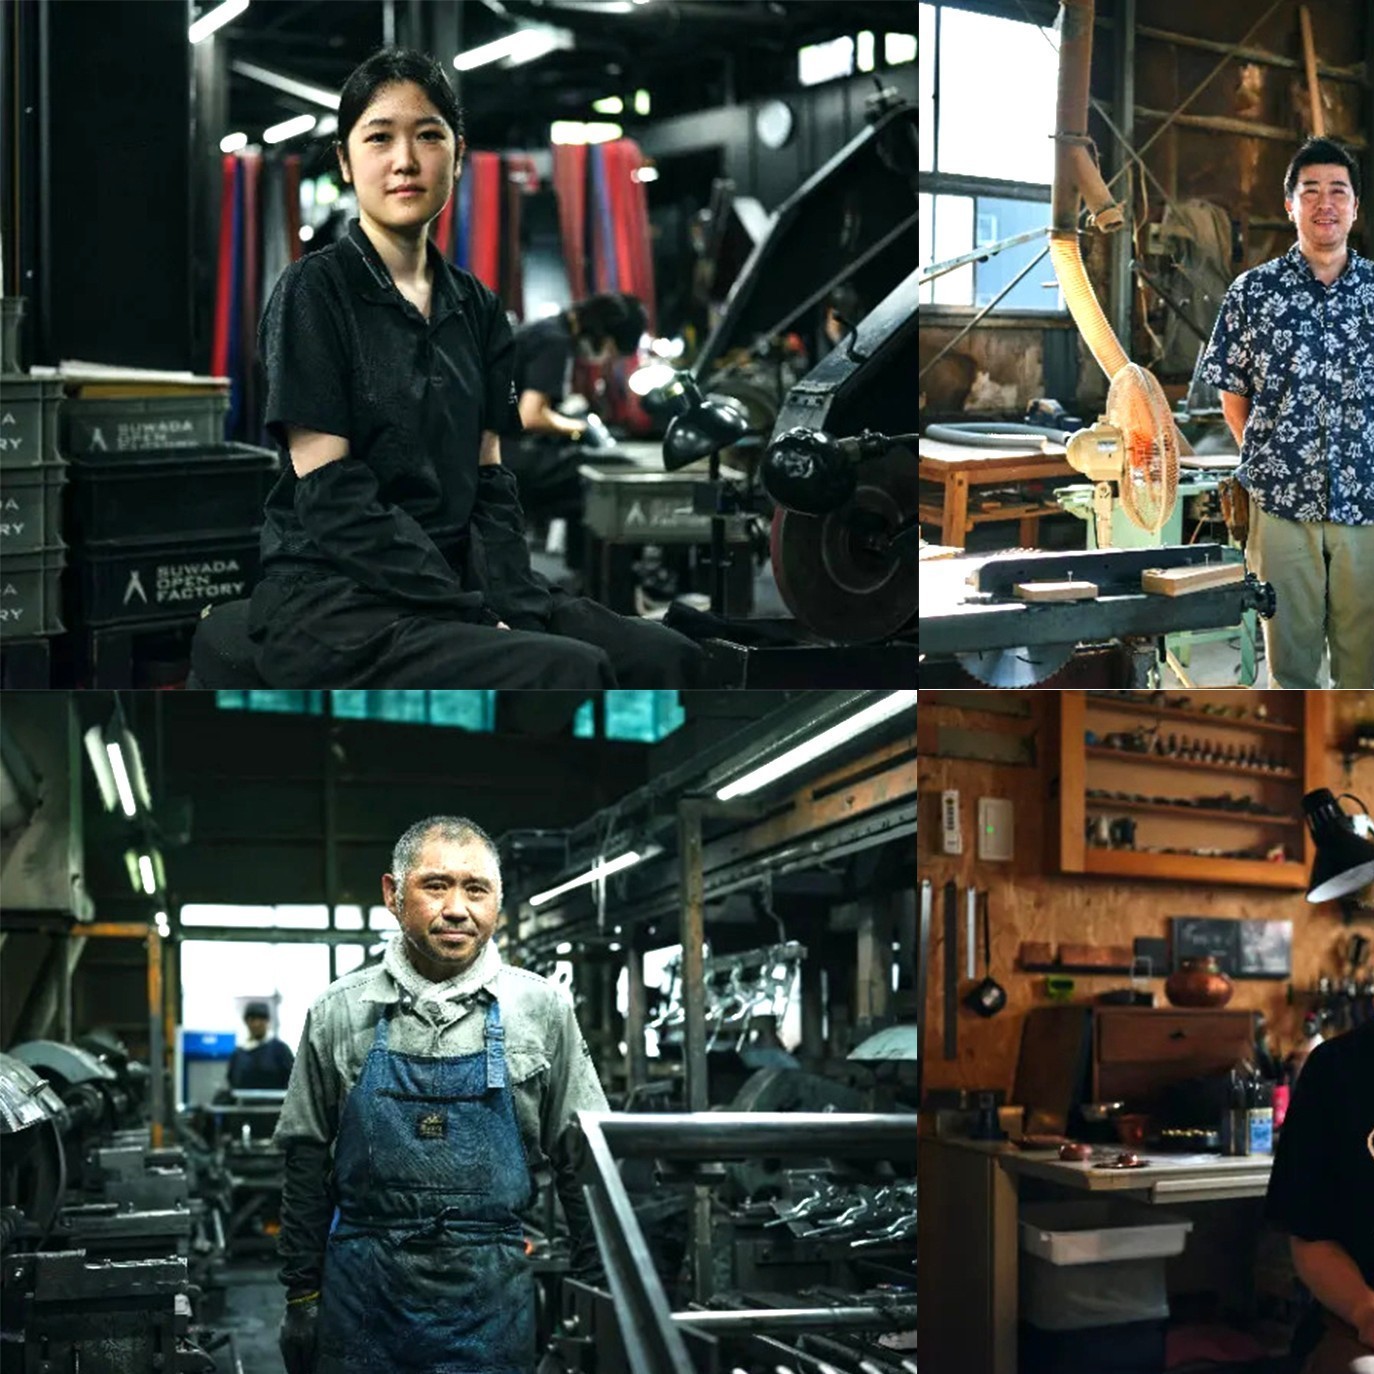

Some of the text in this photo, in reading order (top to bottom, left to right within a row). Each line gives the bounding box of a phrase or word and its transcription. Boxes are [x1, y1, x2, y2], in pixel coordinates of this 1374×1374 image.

[157, 560, 240, 577] SUWADA
[157, 575, 210, 589] OPEN
[157, 581, 245, 602] FACTORY
